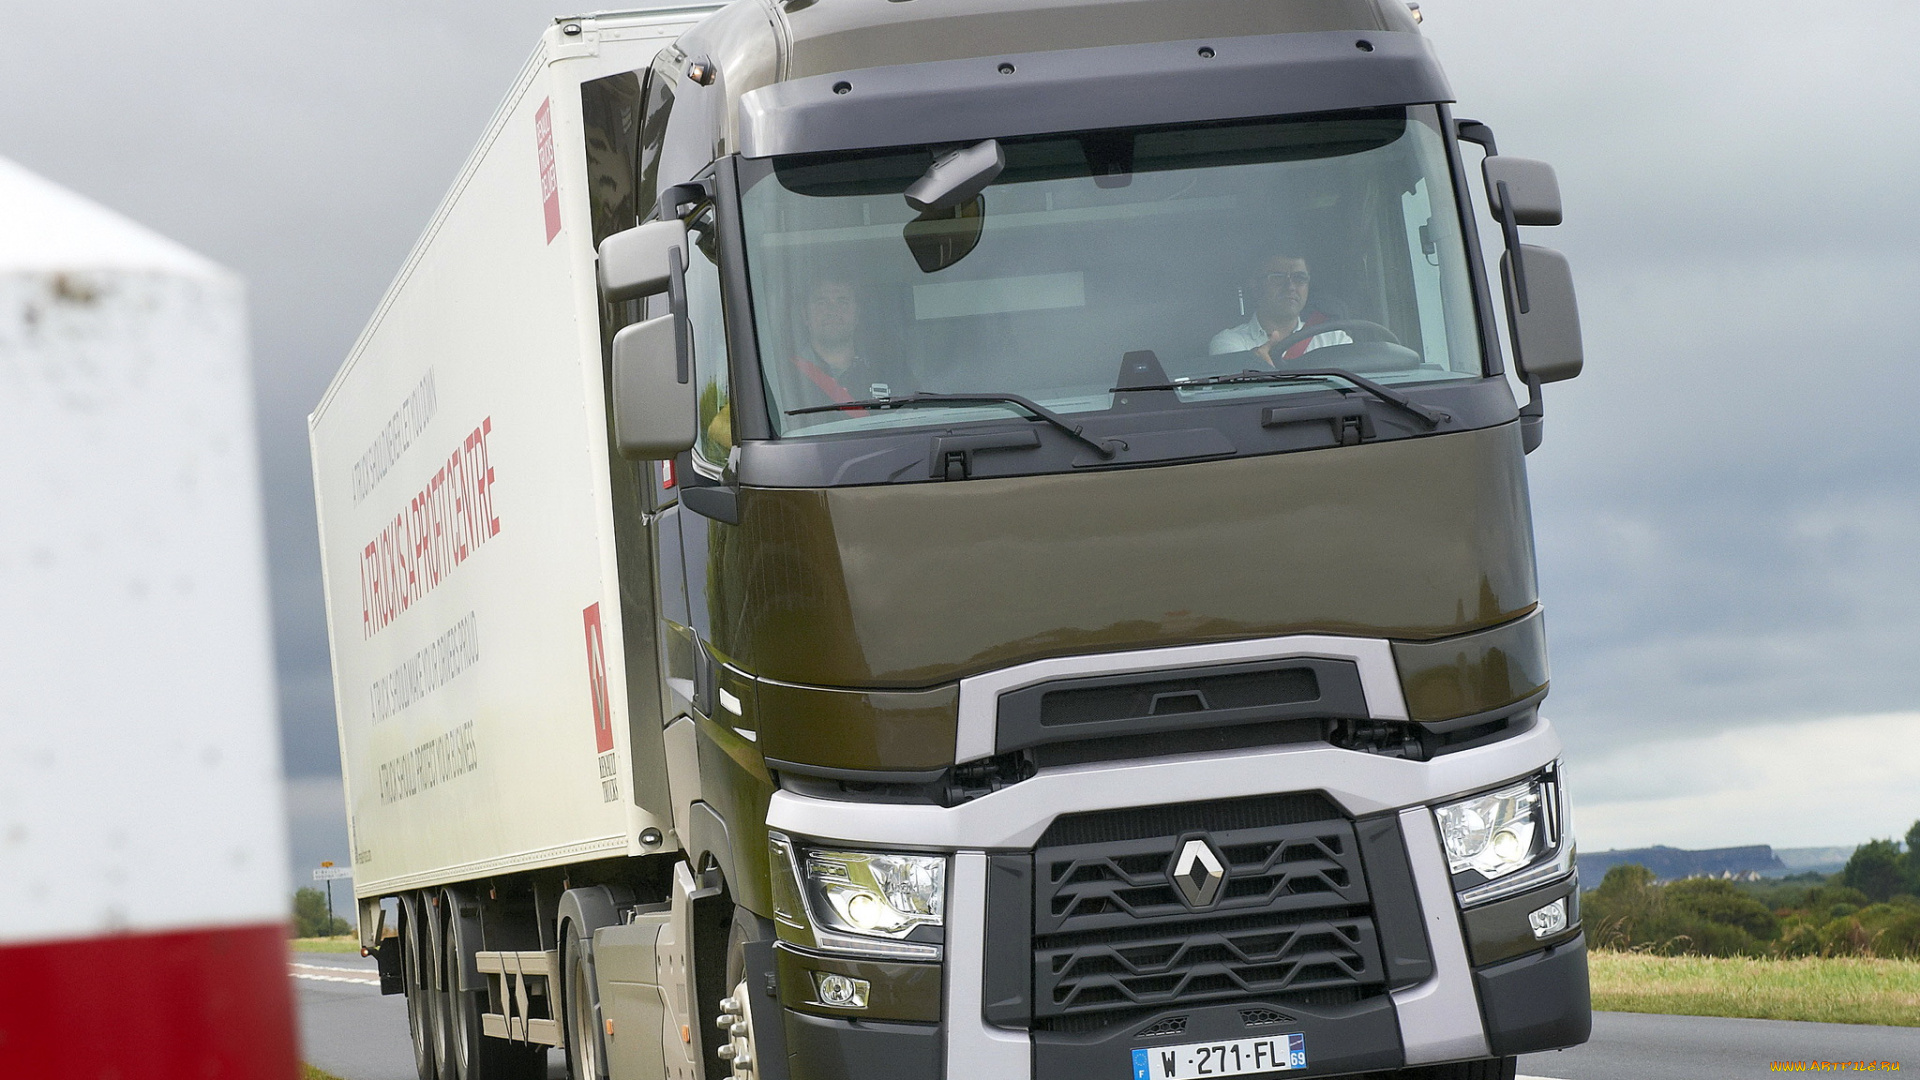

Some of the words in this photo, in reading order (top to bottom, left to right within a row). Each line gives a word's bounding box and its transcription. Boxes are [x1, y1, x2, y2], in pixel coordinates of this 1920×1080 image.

[412, 466, 451, 597] PROFIT
[447, 415, 501, 566] CENTRE
[360, 551, 371, 641] A
[365, 520, 400, 634] TRUCK
[395, 513, 408, 611] IS
[405, 506, 418, 605] A
[598, 752, 617, 779] RENAULT
[602, 777, 619, 803] TRUCKS
[1138, 1070, 1145, 1078] F
[1291, 1052, 1306, 1066] 69
